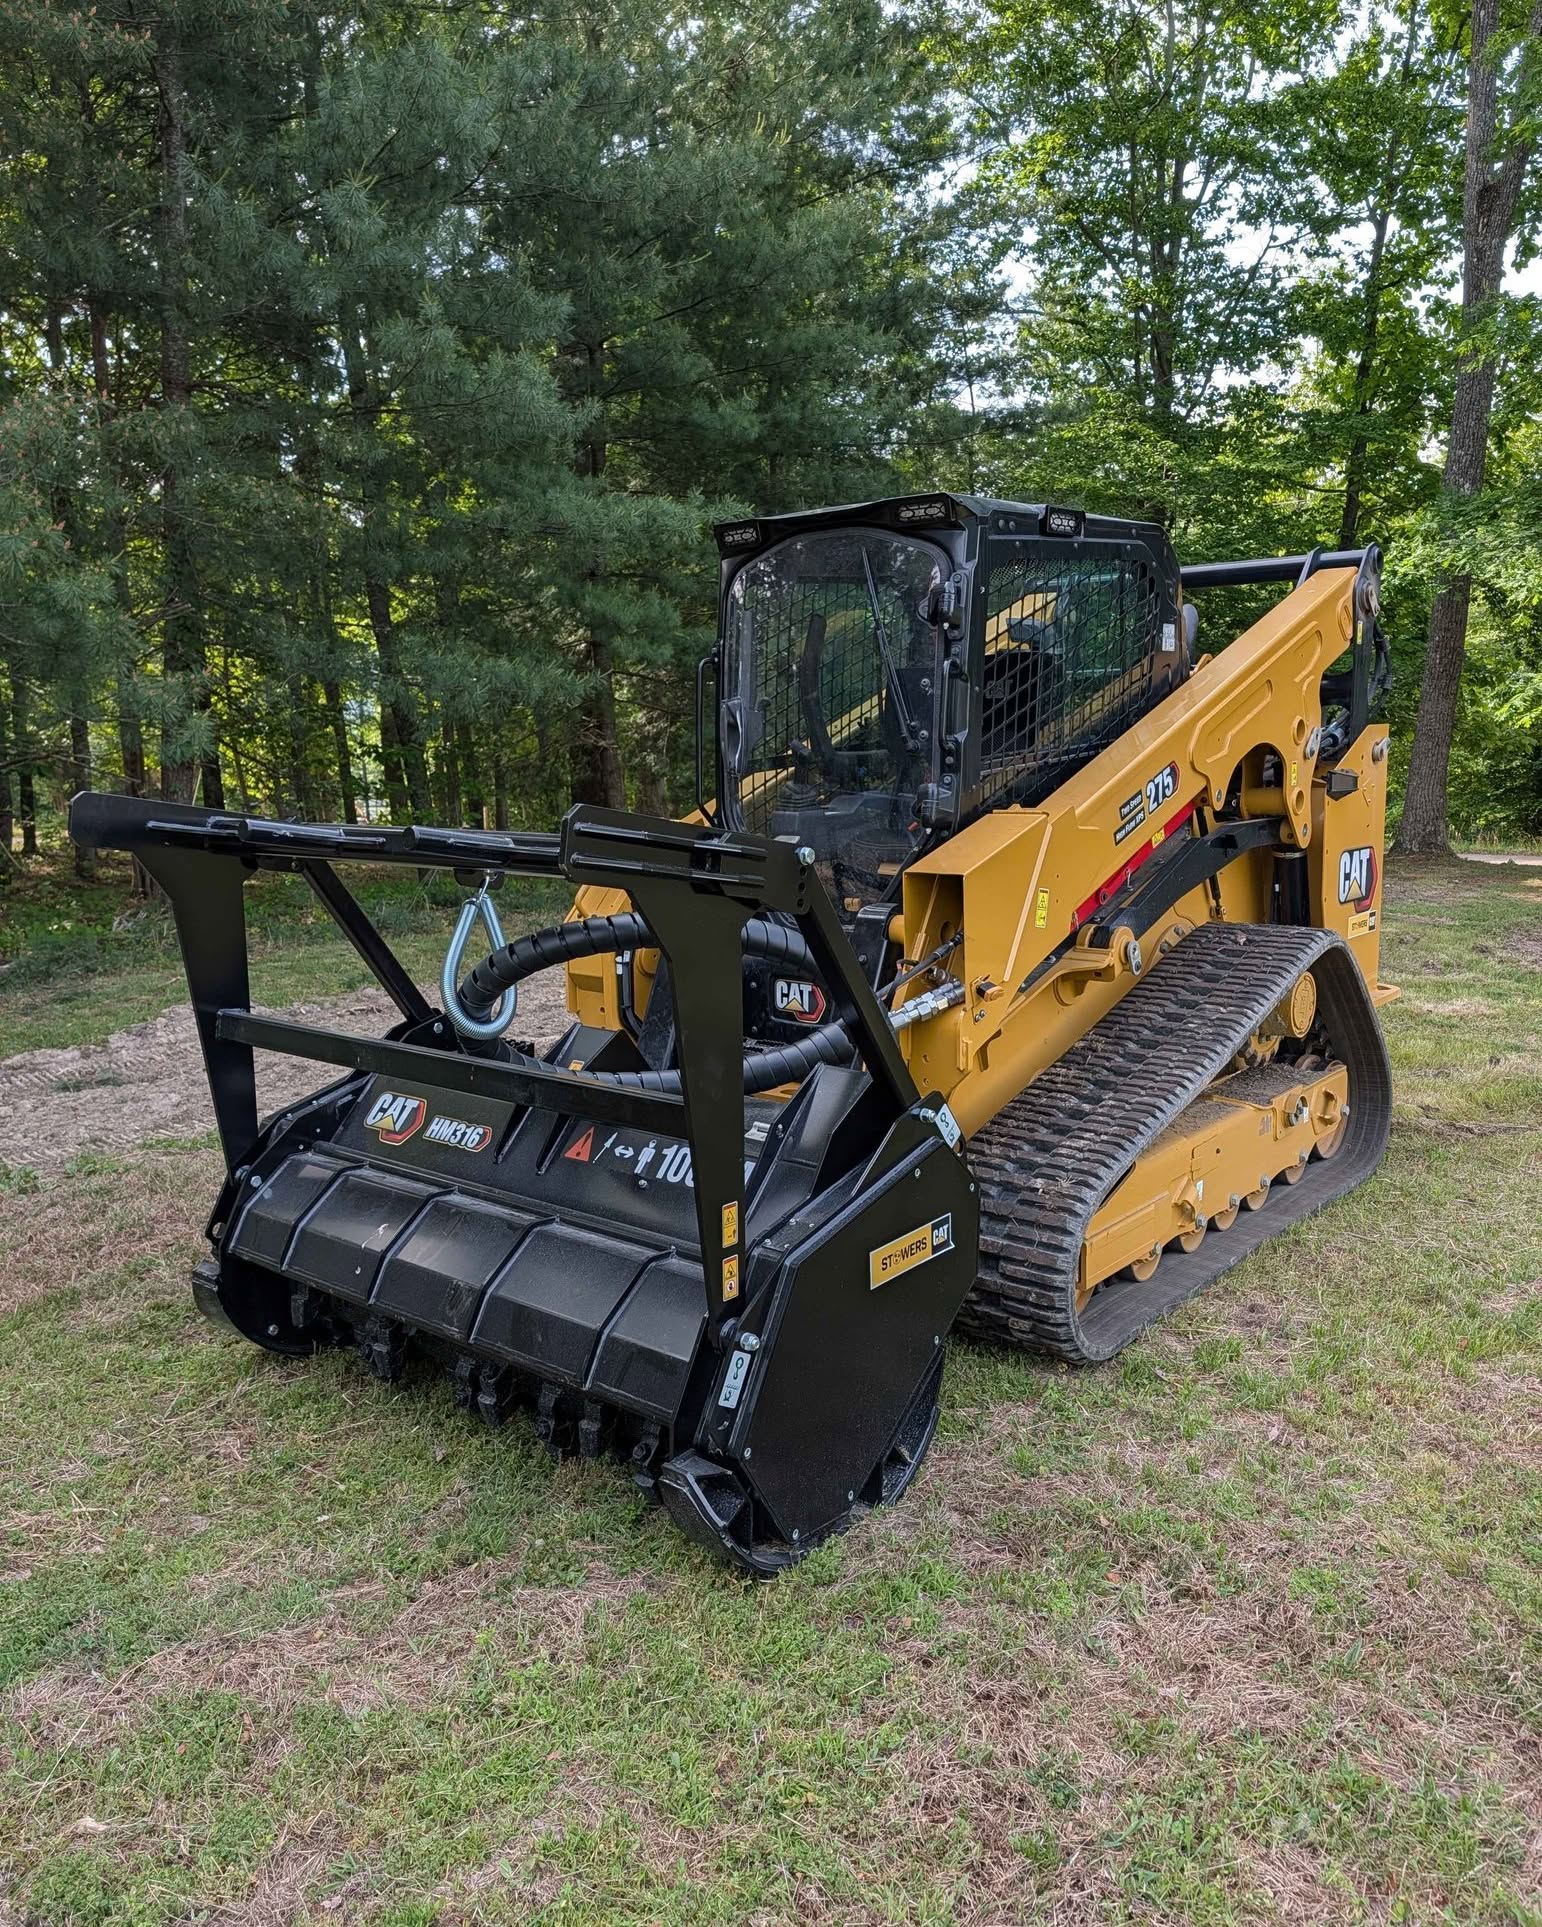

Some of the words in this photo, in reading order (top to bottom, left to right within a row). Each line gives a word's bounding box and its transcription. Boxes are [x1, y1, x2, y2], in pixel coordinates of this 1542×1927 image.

[1147, 766, 1173, 813] 275
[1340, 848, 1370, 903] CAT
[776, 981, 812, 1012] CAT
[366, 1093, 420, 1132] CAT
[425, 1118, 483, 1148] HM316
[881, 1236, 927, 1271] STOWERS
[933, 1224, 949, 1246] CAT
